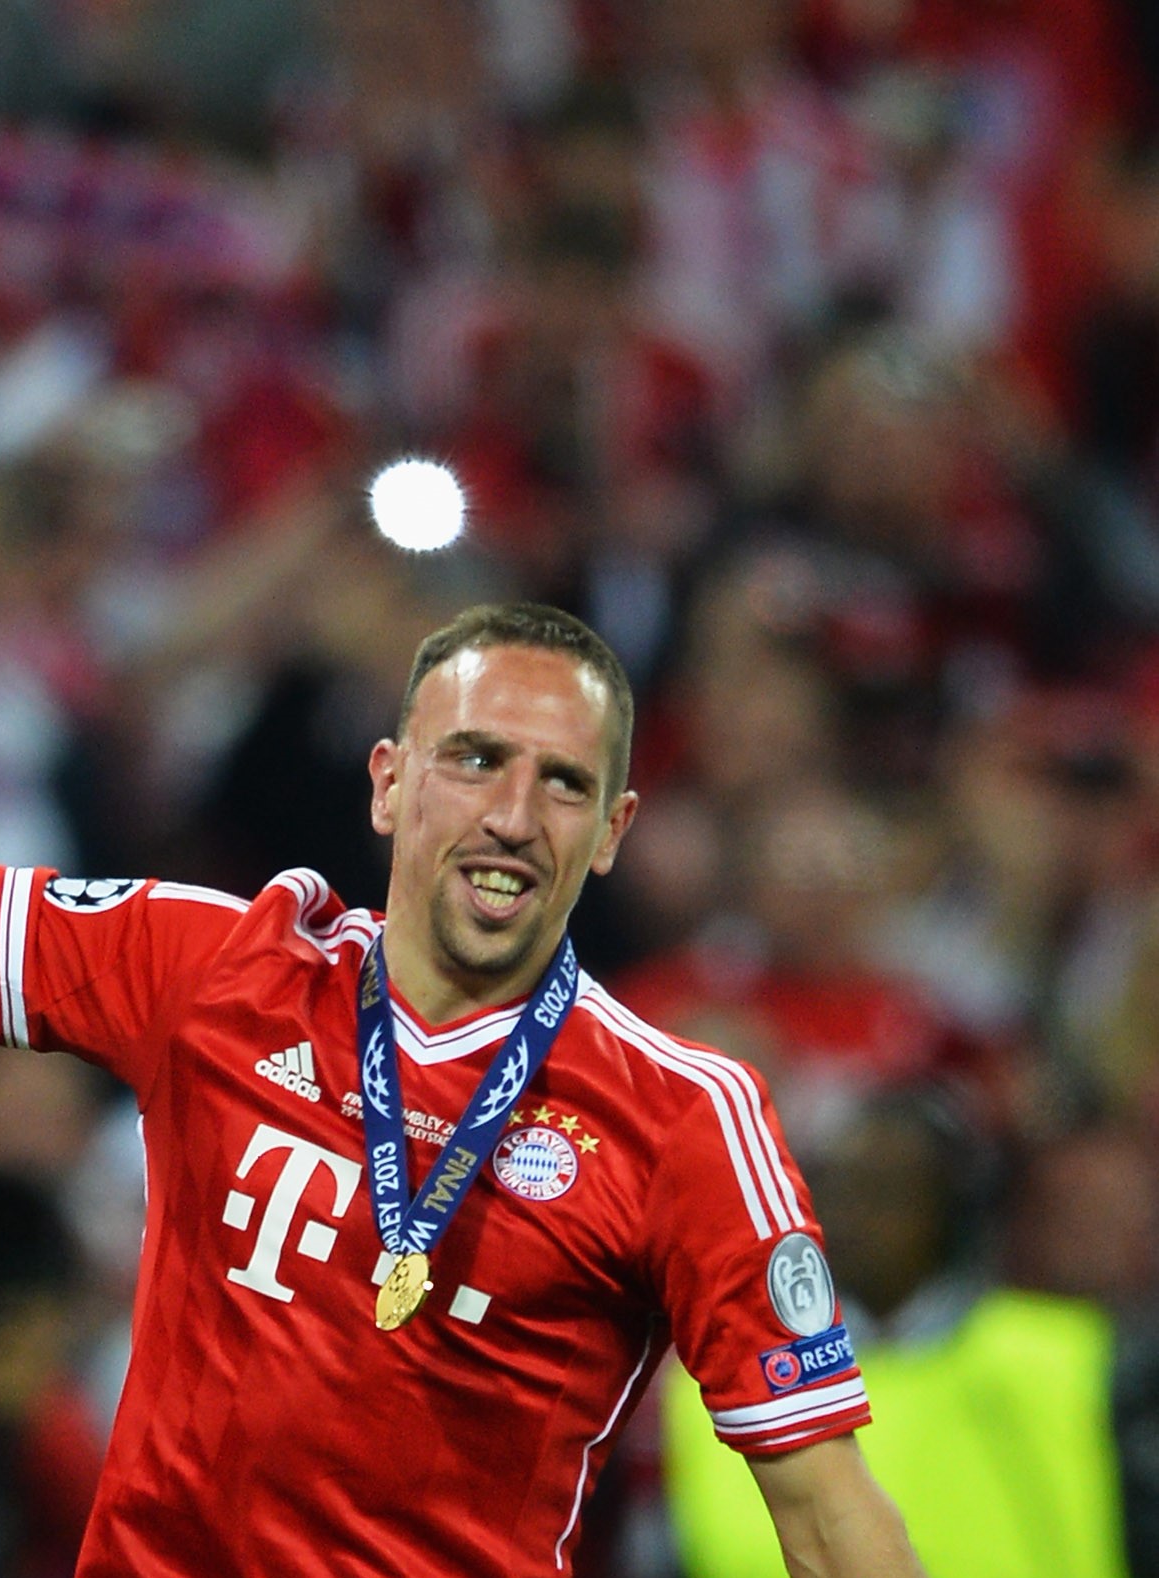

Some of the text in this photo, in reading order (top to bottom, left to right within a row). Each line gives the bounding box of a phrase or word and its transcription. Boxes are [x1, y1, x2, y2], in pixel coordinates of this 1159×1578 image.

[533, 978, 571, 1029] 2013
[254, 1058, 322, 1103] adidas
[372, 1141, 399, 1196] 2013
[422, 1146, 478, 1214] FINAL
